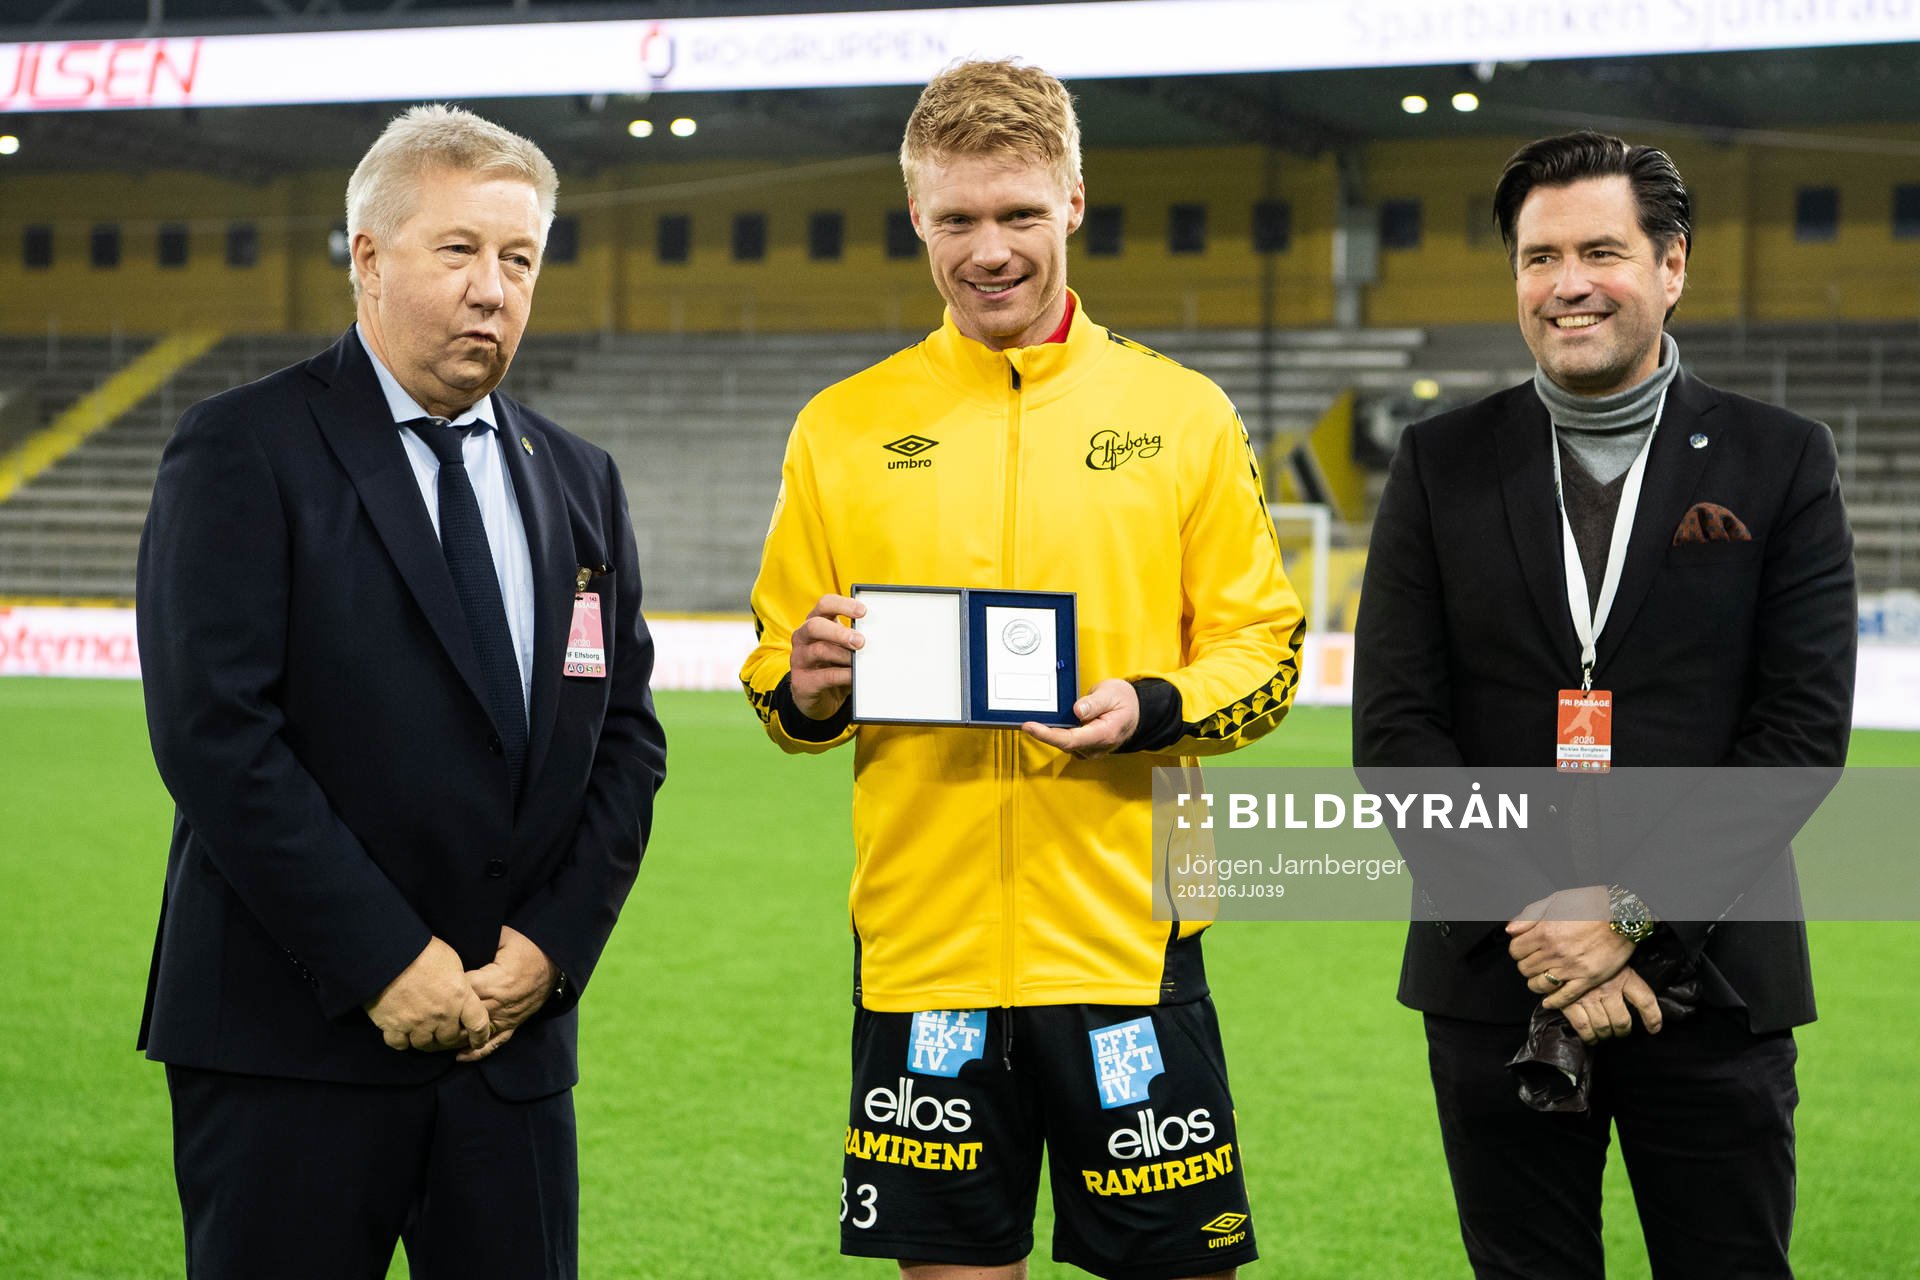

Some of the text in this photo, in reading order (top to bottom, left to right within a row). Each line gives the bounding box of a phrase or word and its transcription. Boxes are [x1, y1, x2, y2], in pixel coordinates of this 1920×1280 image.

[887, 458, 932, 470] umbro
[1085, 429, 1164, 471] Elfsborg
[574, 652, 600, 660] Elfsborg
[1574, 699, 1610, 707] PASSAGE
[1574, 736, 1595, 744] 2020
[915, 1021, 981, 1051] EKT
[1094, 1024, 1141, 1058] EFF
[1098, 1045, 1154, 1080] EKT
[864, 1077, 972, 1133] ellos
[1108, 1108, 1216, 1159] ellos
[1082, 1143, 1234, 1196] RAMIRENT
[1208, 1231, 1246, 1248] umbro
